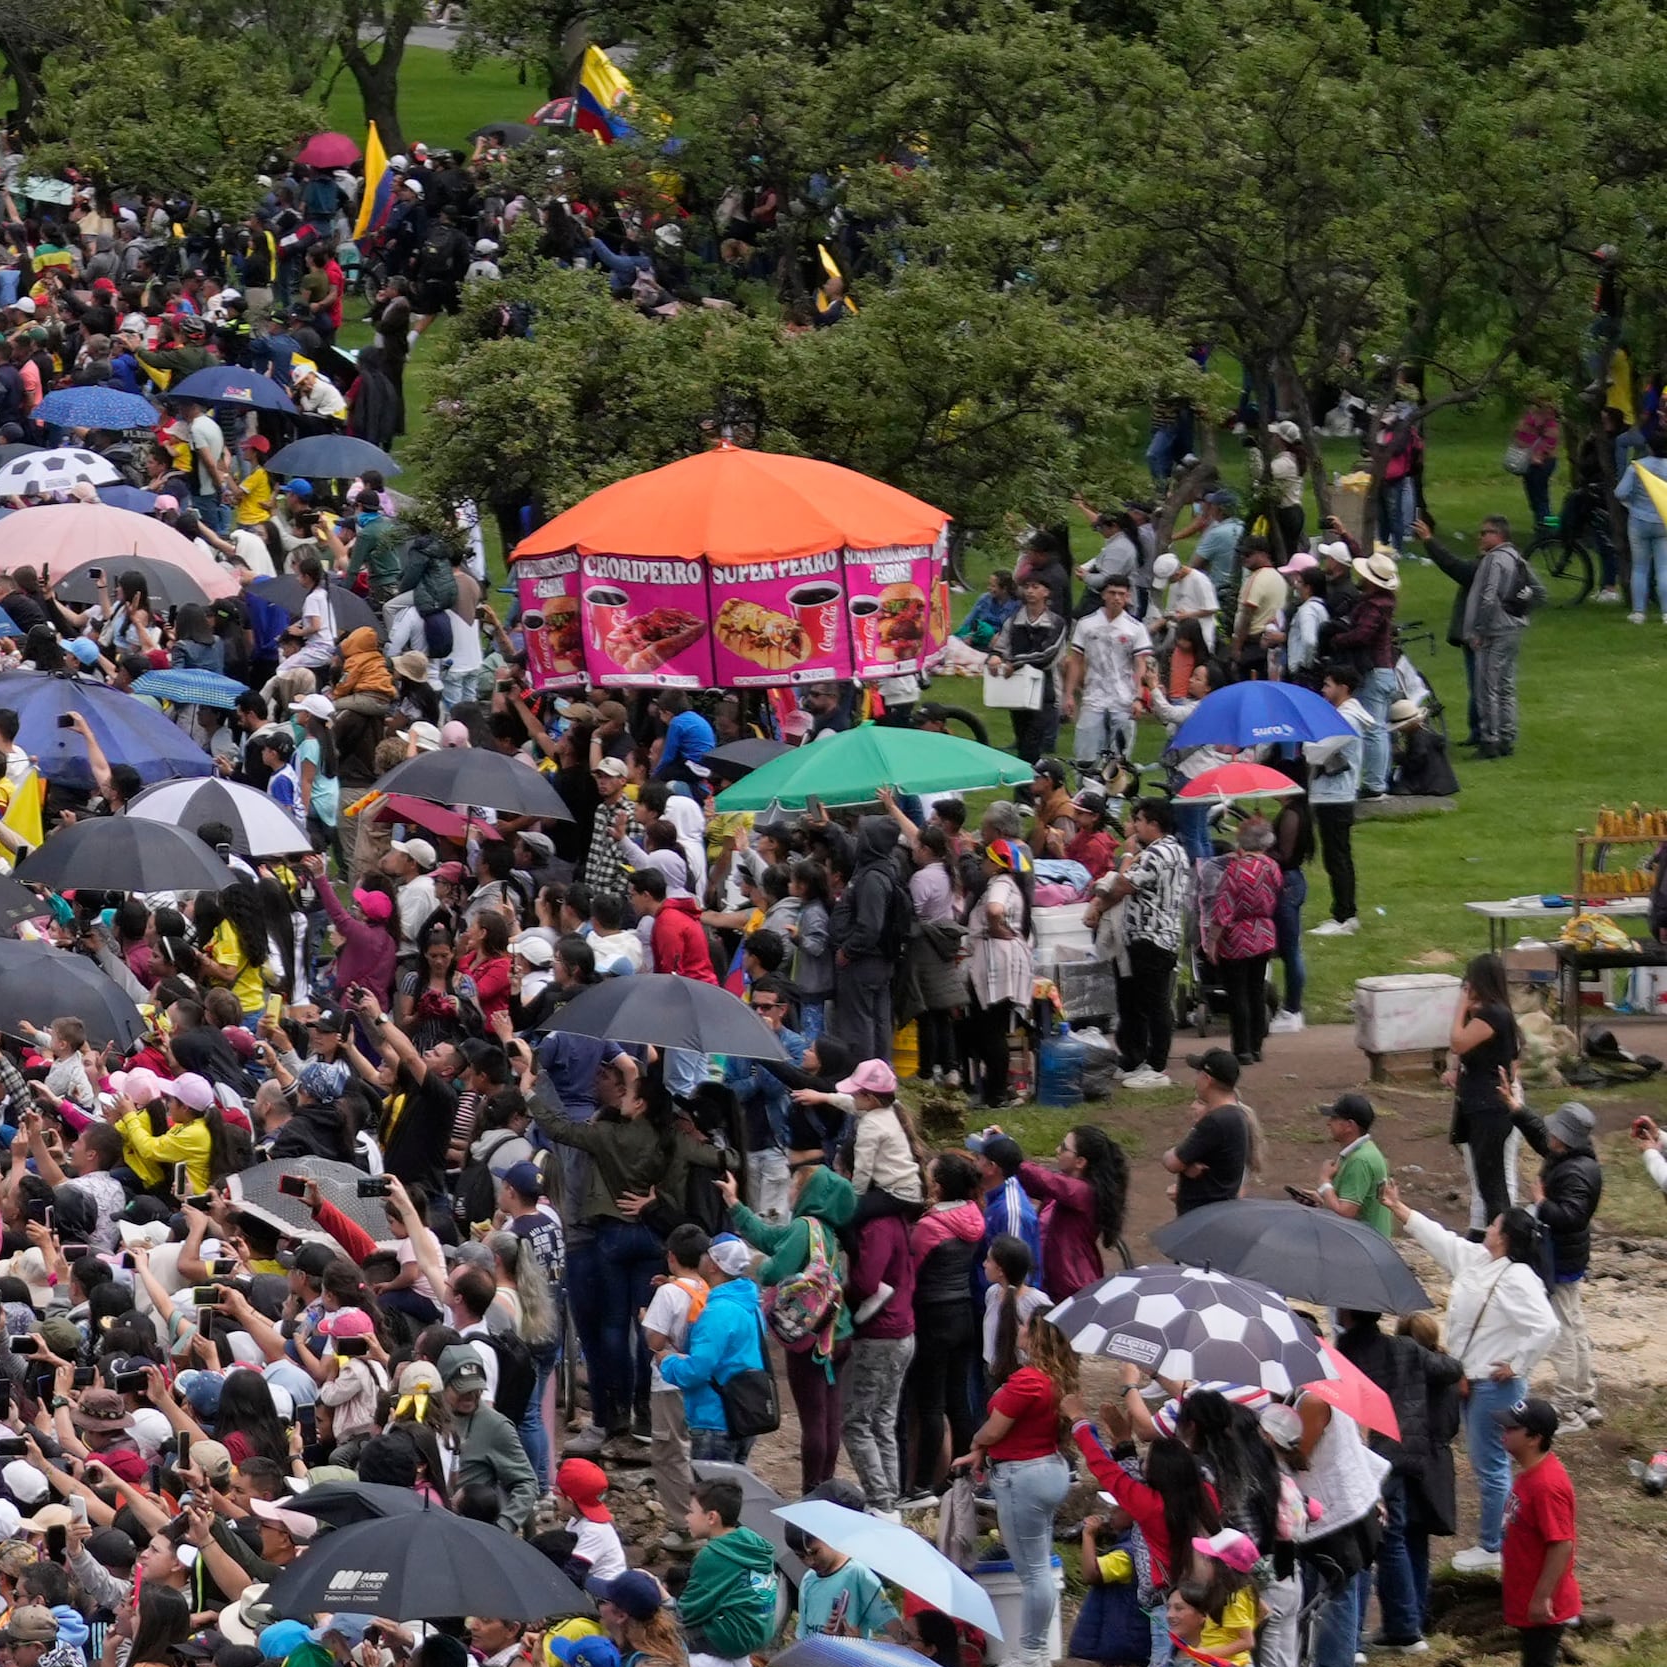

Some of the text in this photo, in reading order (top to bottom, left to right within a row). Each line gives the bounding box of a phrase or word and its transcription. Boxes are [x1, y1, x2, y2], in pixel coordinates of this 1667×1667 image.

[583, 556, 702, 585] CHORIPERRO
[712, 550, 838, 585] SUPER PERRO
[1252, 724, 1282, 737] sura
